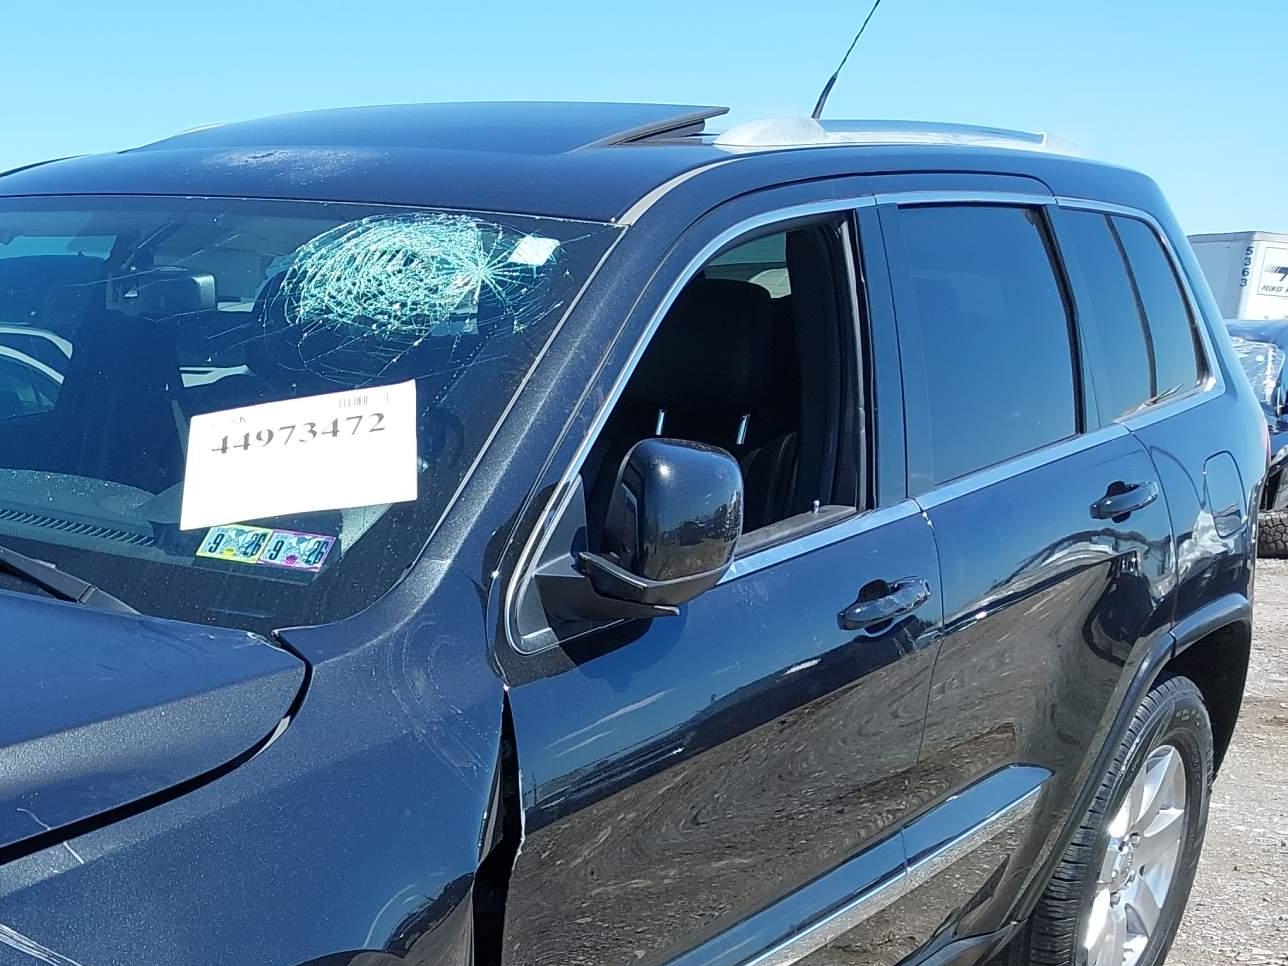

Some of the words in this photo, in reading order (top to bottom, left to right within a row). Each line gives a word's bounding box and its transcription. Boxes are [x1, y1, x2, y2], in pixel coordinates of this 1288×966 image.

[1239, 246, 1254, 287] 5363
[211, 412, 386, 455] 44973472
[208, 533, 225, 554] 9
[268, 540, 285, 561] 9
